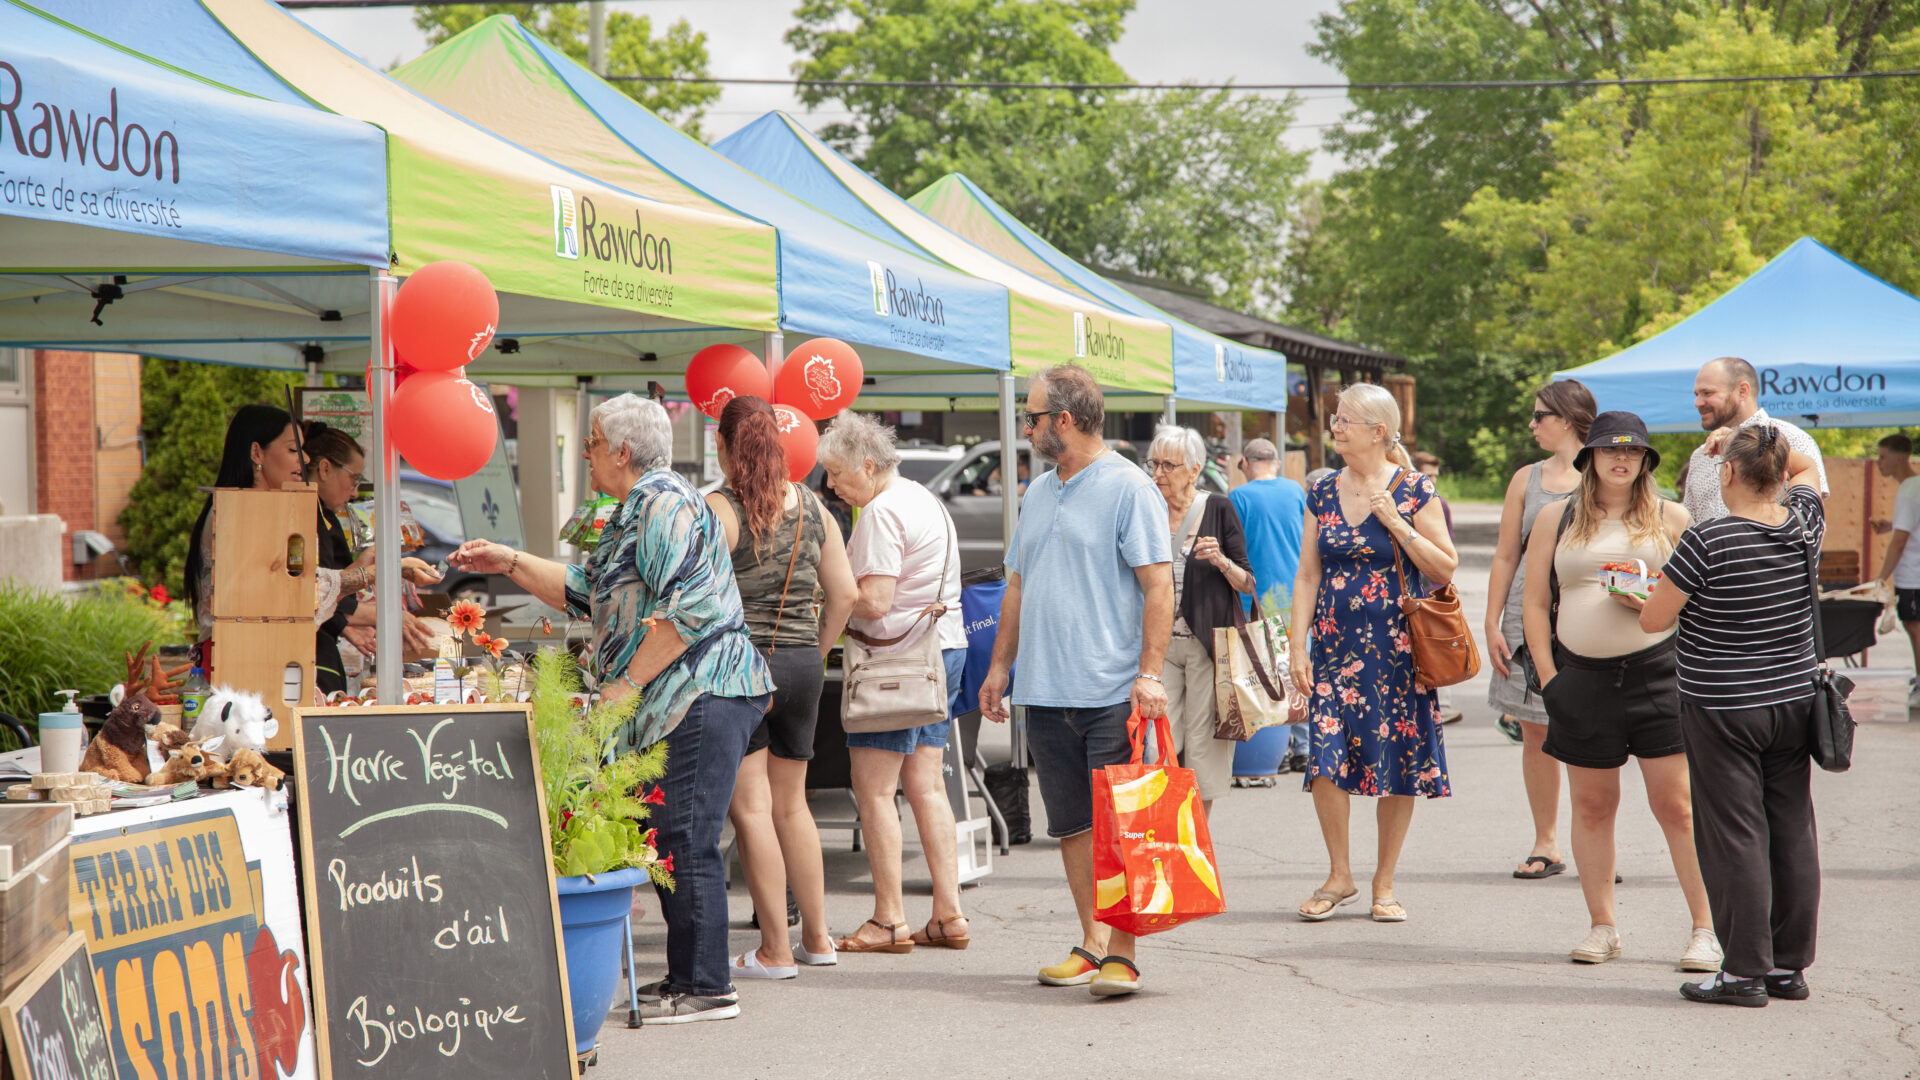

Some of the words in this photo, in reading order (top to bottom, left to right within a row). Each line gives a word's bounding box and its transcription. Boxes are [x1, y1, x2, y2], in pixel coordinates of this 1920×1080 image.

[0, 61, 180, 184] Rawdon
[52, 177, 75, 212] de
[80, 191, 99, 216] sa
[103, 187, 183, 229] diversité
[581, 196, 673, 275] Rawdon
[583, 270, 610, 296] Forte
[611, 274, 623, 298] de
[624, 280, 635, 300] sa
[636, 278, 673, 308] diversité
[886, 268, 946, 328] Rawdon
[890, 323, 906, 344] Forte
[906, 327, 915, 346] de
[1085, 316, 1125, 362] Rawdon
[1760, 365, 1886, 397] Rawdon
[1760, 400, 1795, 413] Forte
[1797, 398, 1813, 411] de
[1816, 399, 1830, 410] sa
[1833, 394, 1888, 409] diversité
[971, 614, 997, 632] final.
[318, 724, 408, 806] Havre
[406, 717, 515, 800] Végétal
[1124, 831, 1145, 840] Super
[1145, 828, 1156, 842] C
[73, 838, 184, 941] TERRE
[176, 830, 232, 918] DES
[328, 855, 444, 912] Produits
[433, 905, 510, 950] d'ail
[346, 994, 527, 1067] Biologique
